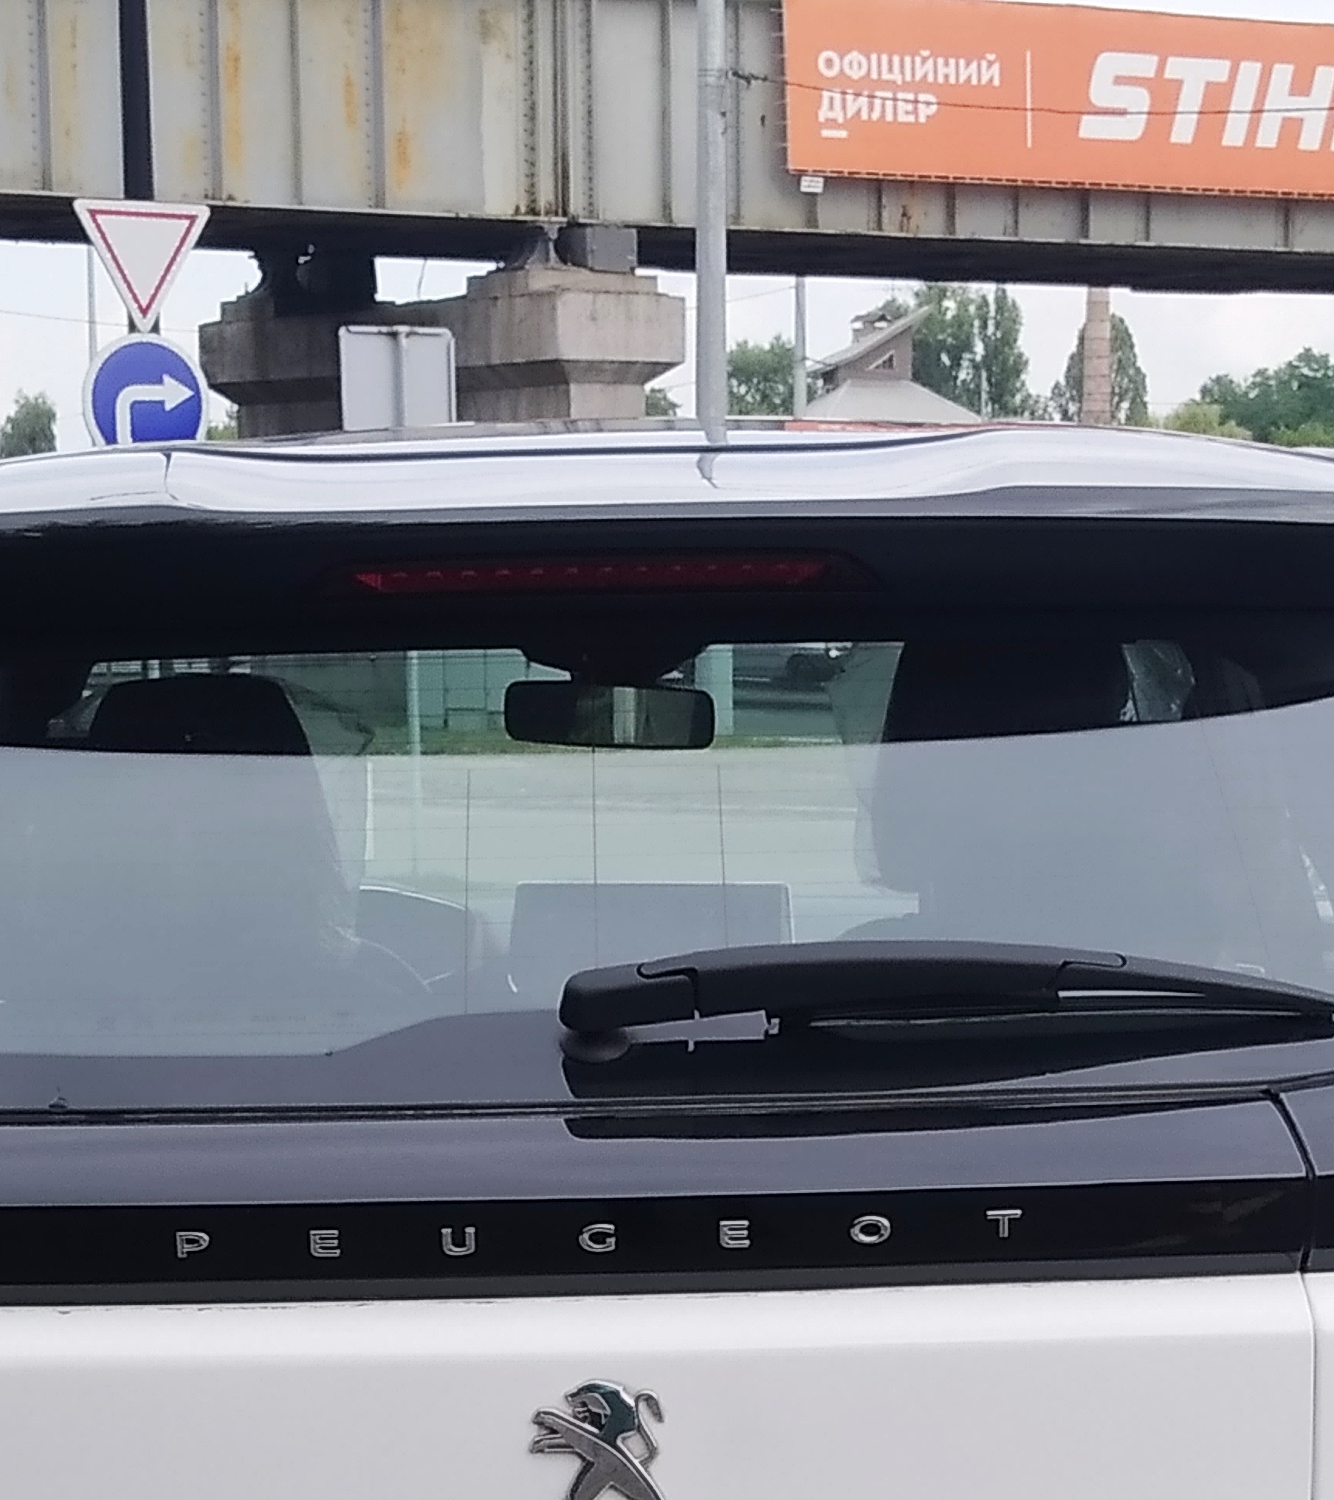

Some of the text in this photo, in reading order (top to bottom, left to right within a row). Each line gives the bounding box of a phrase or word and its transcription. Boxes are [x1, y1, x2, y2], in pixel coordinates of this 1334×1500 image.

[817, 49, 1001, 87] ОФІЦІЙНИЙ
[818, 89, 939, 124] ДИЛЕР
[175, 1208, 1024, 1259] PEUGEOT
